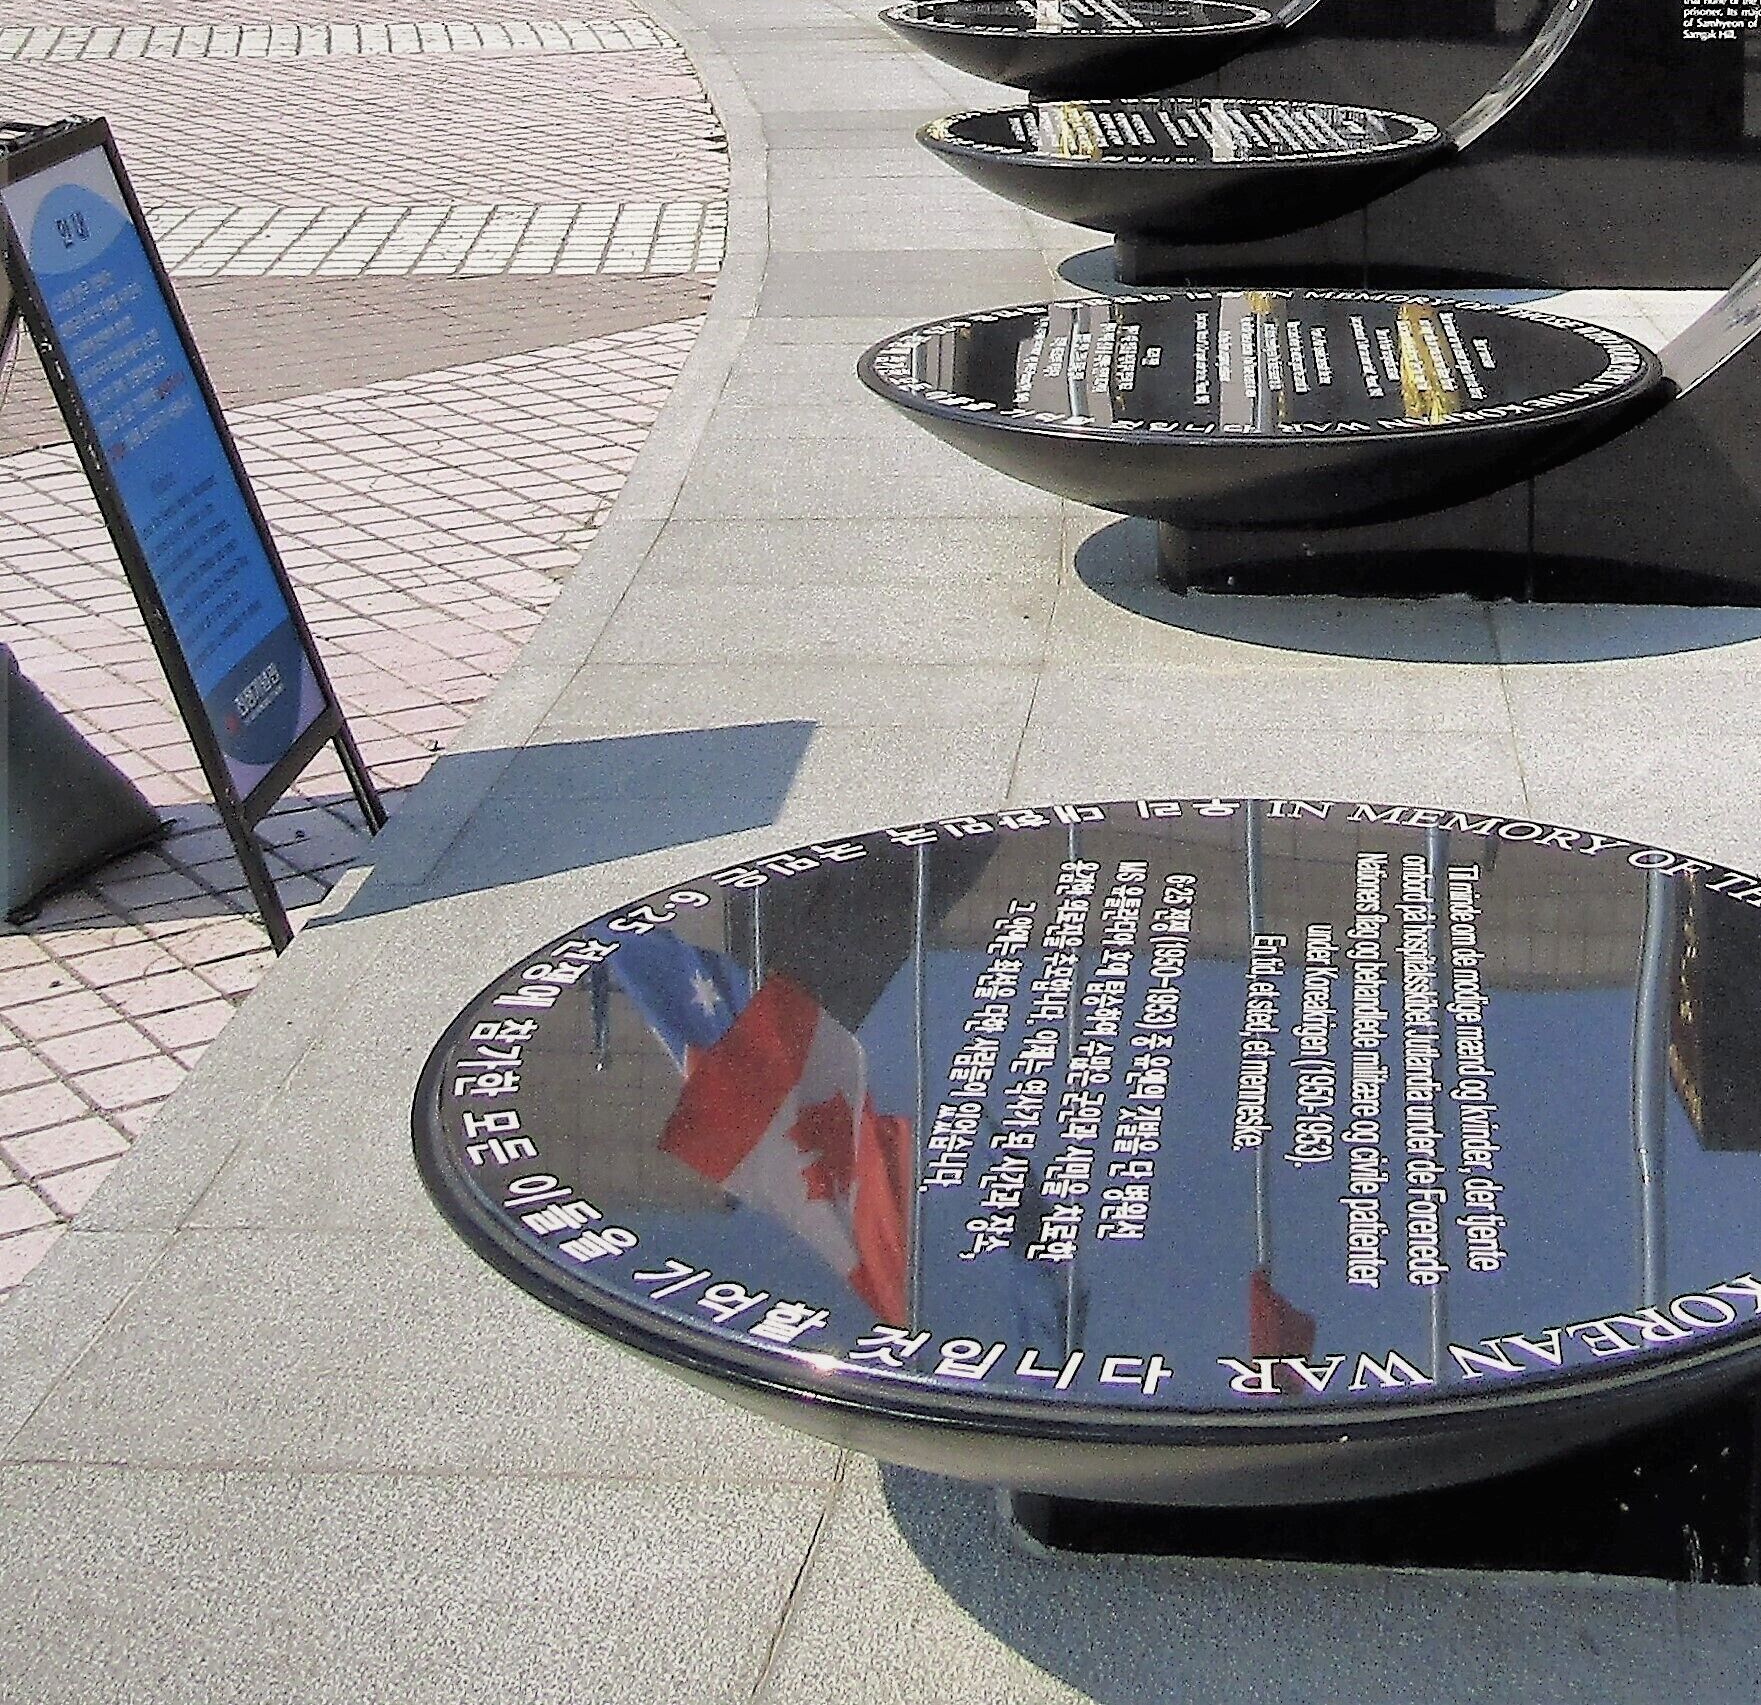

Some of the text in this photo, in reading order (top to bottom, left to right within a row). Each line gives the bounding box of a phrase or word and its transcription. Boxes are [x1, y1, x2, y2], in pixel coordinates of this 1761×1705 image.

[886, 803, 1106, 847] 대한민국
[1267, 799, 1334, 819] IN
[1348, 802, 1630, 856] MEMORY
[711, 842, 868, 889] 국민은
[1627, 848, 1714, 878] OF
[1449, 882, 1483, 922] minde
[1451, 924, 1475, 944] om
[1452, 948, 1485, 966] de
[493, 939, 621, 1008] 전쟁에
[1446, 969, 1489, 1022] modige
[454, 1019, 539, 1097] 참가한
[1232, 934, 1286, 1152] En tid, et sted, et menneske.
[1455, 1025, 1495, 1075] mænd
[1450, 1080, 1483, 1099] og
[463, 1110, 539, 1166] 모든
[1457, 1105, 1499, 1174] kvinder,
[503, 1174, 639, 1264] 이들을
[1462, 1177, 1503, 1211] der
[1455, 1214, 1507, 1272] tjente
[633, 1259, 831, 1343] 기억할
[848, 1324, 1174, 1395] 것입니다
[1217, 1349, 1438, 1394] WAR
